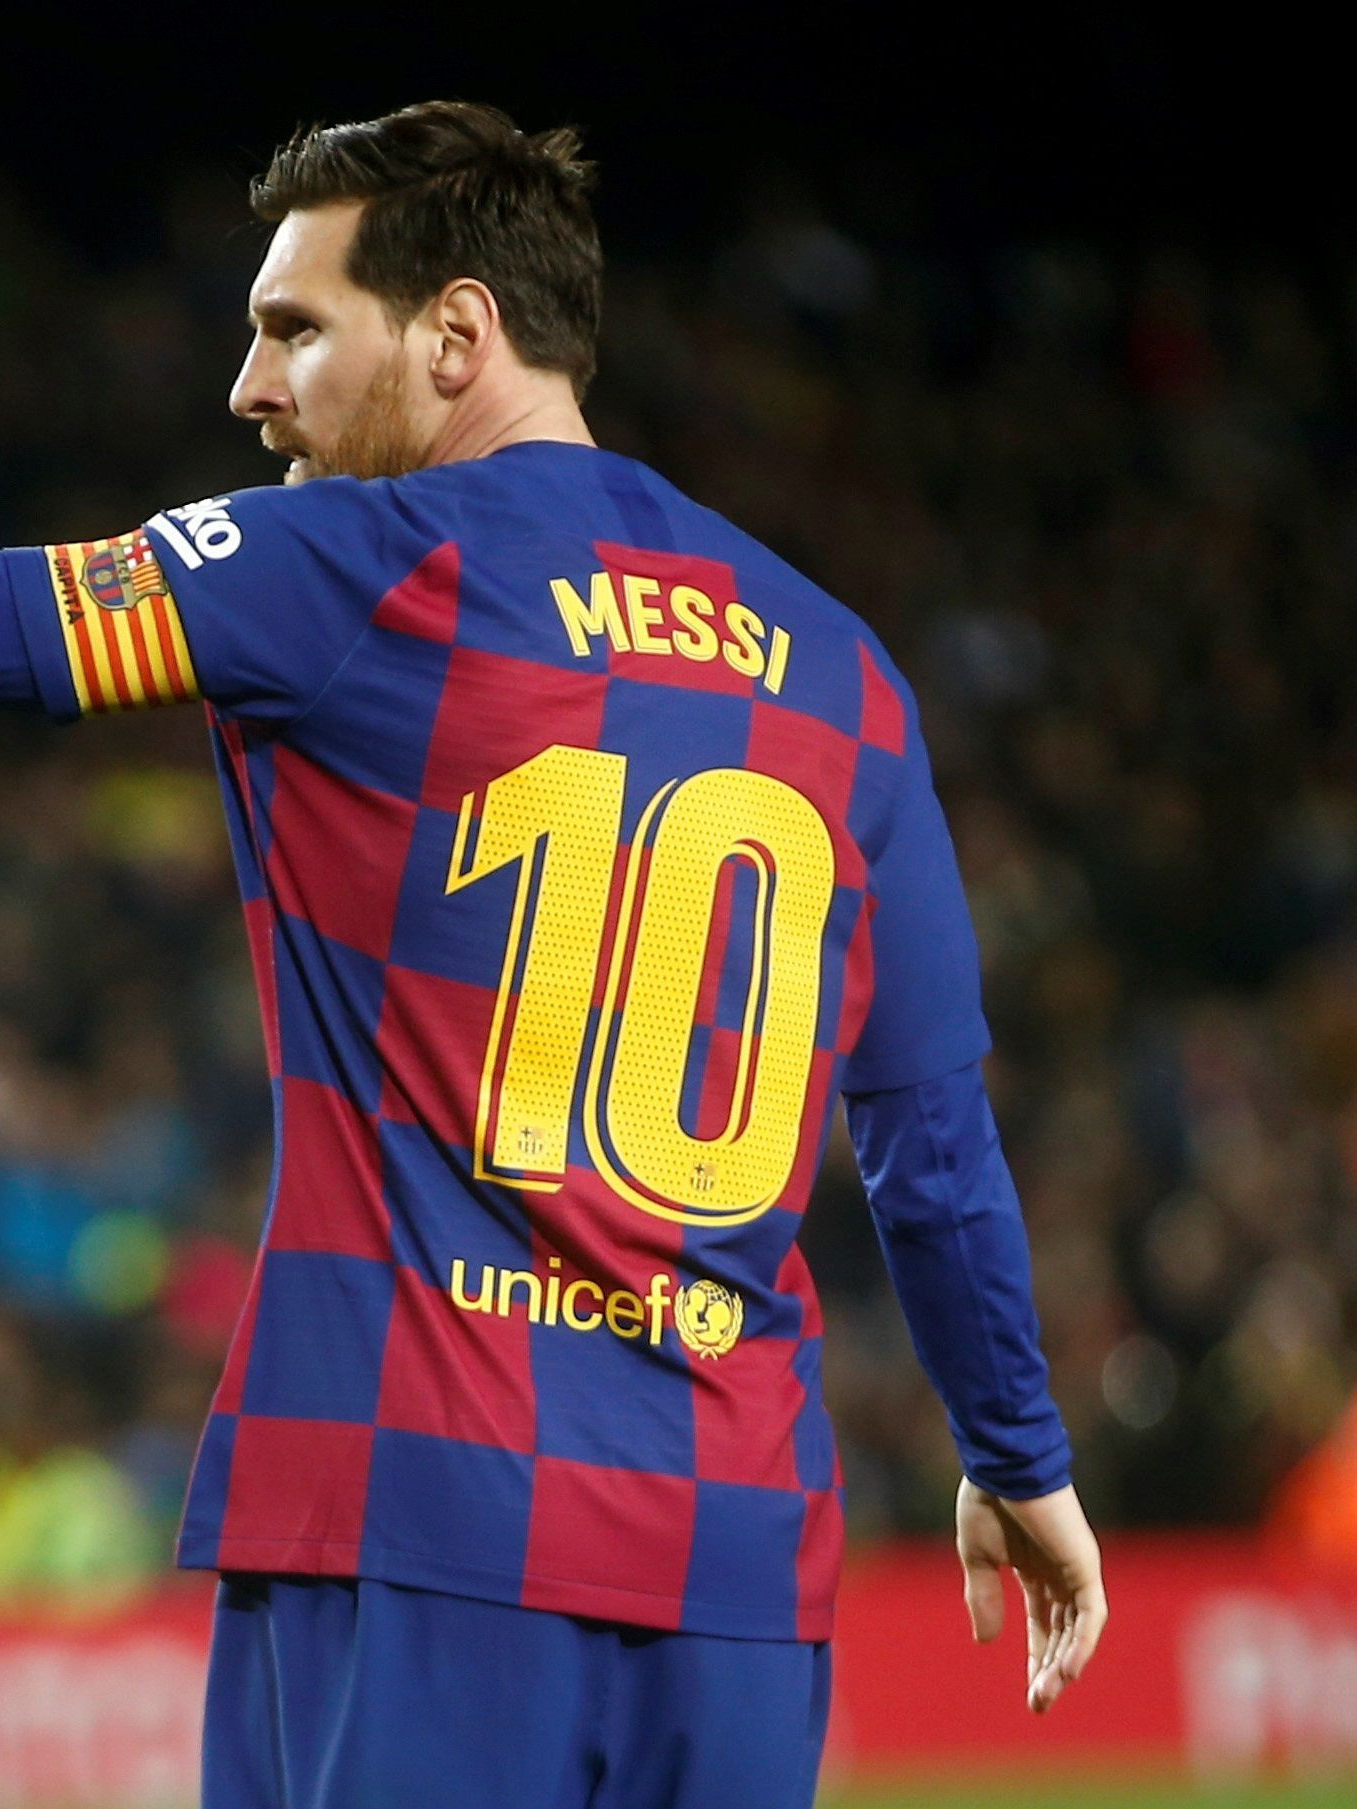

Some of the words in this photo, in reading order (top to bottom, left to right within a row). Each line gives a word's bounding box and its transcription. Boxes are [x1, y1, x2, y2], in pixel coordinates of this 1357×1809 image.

[549, 571, 792, 696] MESSI
[444, 743, 836, 1227] 10
[451, 1256, 671, 1346] unicef
